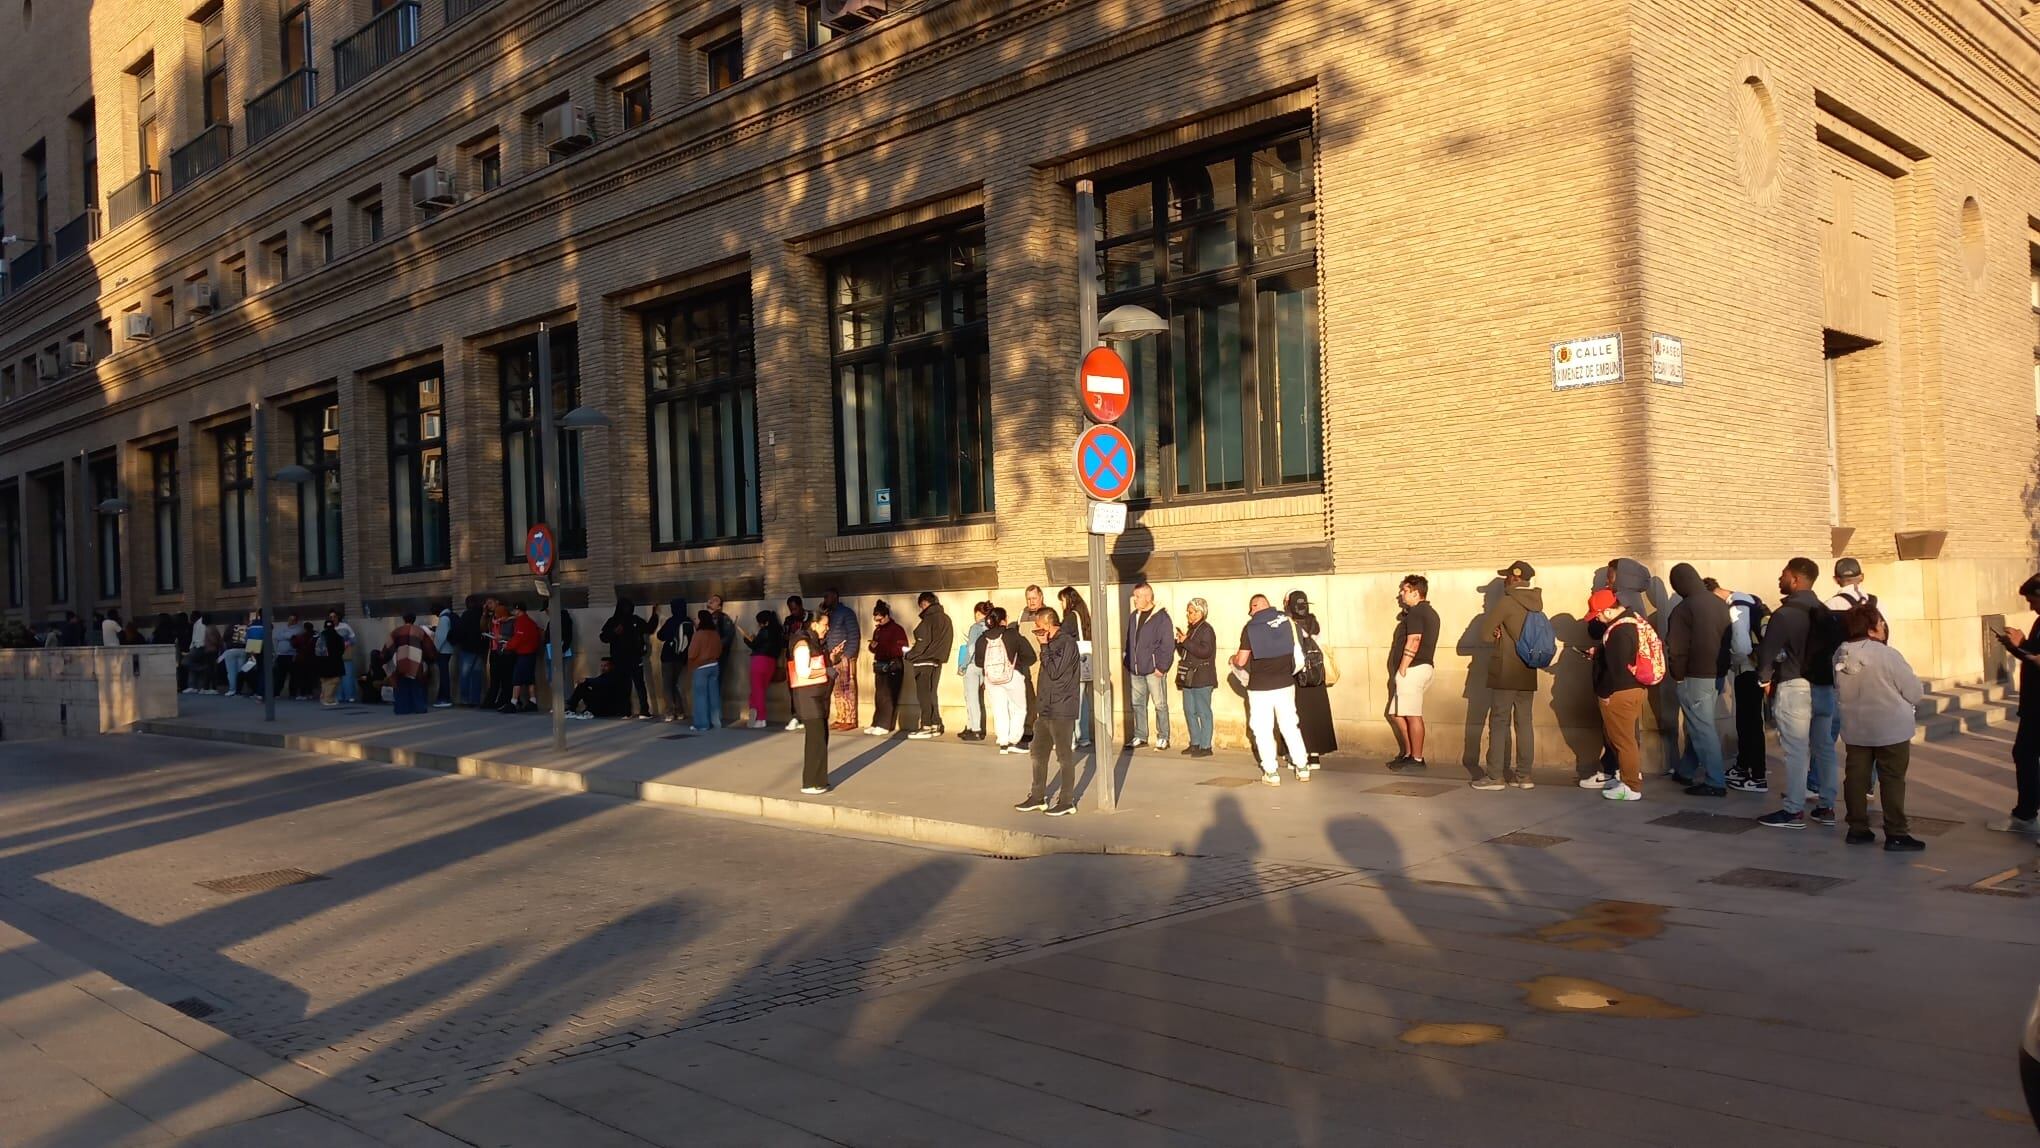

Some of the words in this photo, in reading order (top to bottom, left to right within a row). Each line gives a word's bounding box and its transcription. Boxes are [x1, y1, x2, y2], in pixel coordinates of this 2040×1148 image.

[1575, 344, 1612, 359] CALLE
[1662, 344, 1681, 358] PASEO
[1585, 364, 1594, 378] DE
